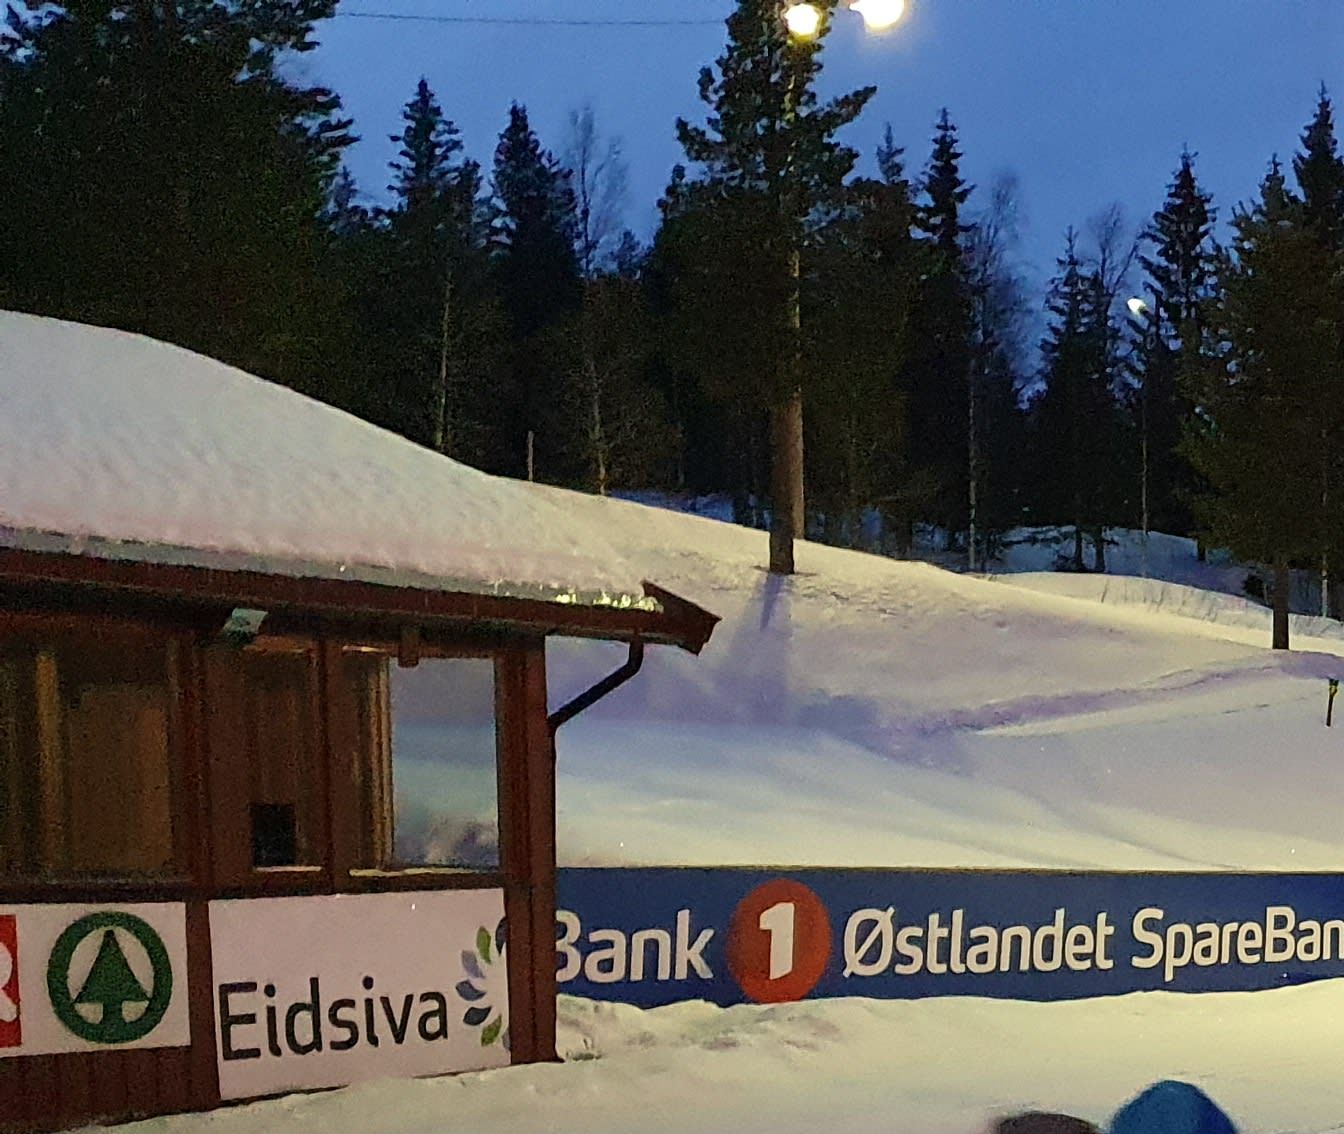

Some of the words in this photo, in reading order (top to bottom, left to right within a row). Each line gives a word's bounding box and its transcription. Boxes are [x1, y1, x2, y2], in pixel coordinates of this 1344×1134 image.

[759, 902, 796, 980] 1
[842, 907, 1114, 978] Østlandet
[218, 976, 449, 1061] Eidsiva
